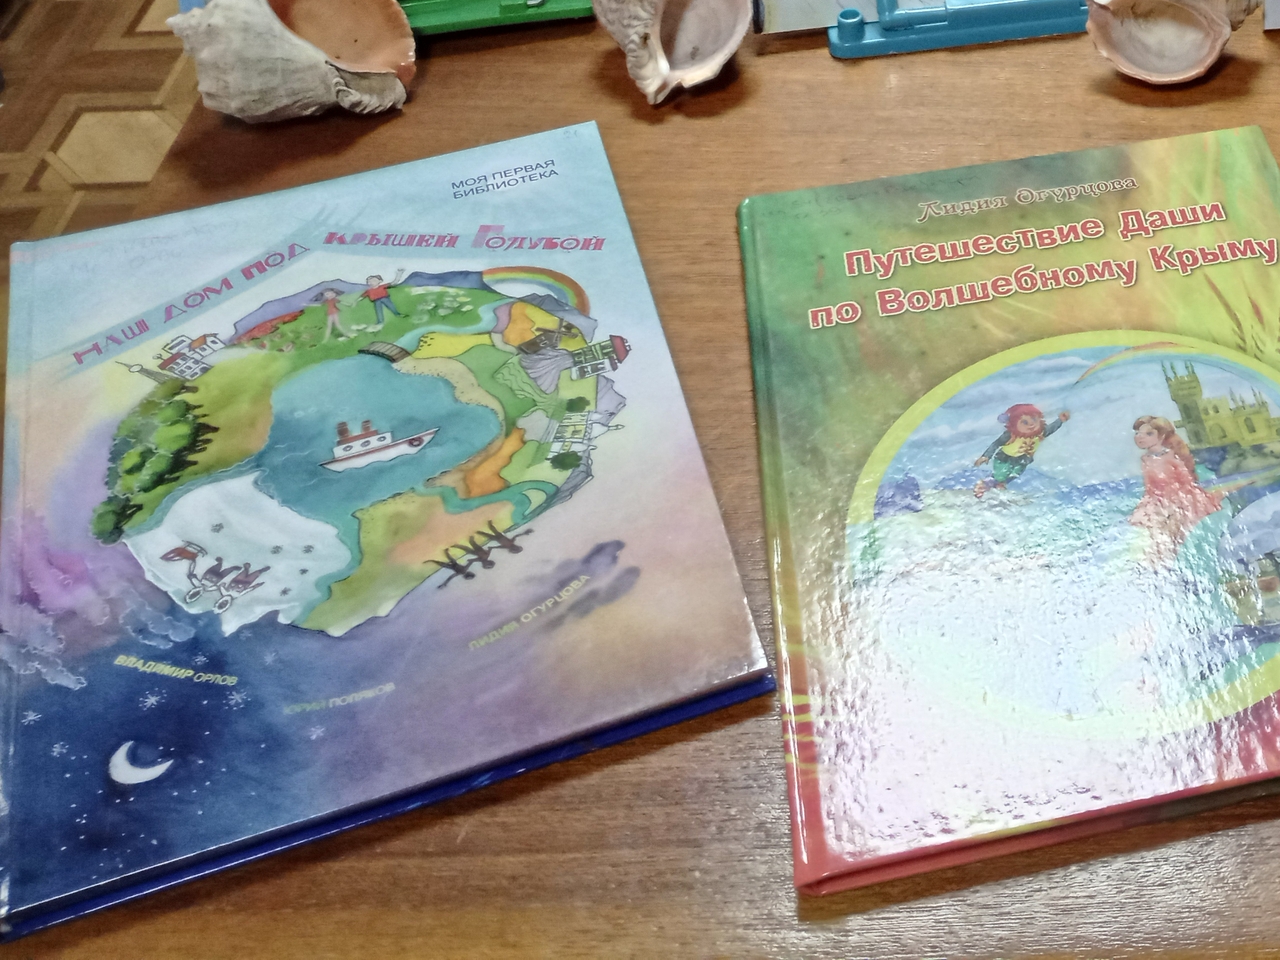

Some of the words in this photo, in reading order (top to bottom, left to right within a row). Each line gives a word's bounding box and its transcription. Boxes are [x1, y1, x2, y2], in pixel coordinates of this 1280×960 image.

[451, 174, 488, 190] МОЯ
[492, 158, 556, 181] ПЕРВАЯ
[452, 168, 560, 200] БИБЛИОТЕКА
[915, 195, 1009, 223] Лидия
[1014, 176, 1139, 205] Огурцова
[844, 217, 1105, 280] Путешествие
[1118, 201, 1226, 240] Даши
[71, 318, 151, 365] НАШ
[163, 277, 234, 324] ДОМ
[240, 242, 311, 281] ПОД
[807, 300, 862, 330] по
[876, 259, 1137, 317] Волшебному
[1148, 237, 1279, 276] Крыму
[467, 620, 520, 651] ЛИДИЯ
[520, 574, 591, 623] ОГУРЦОВА
[113, 654, 194, 680] ВЛАДИМИР
[193, 671, 239, 687] ОРЛОВ
